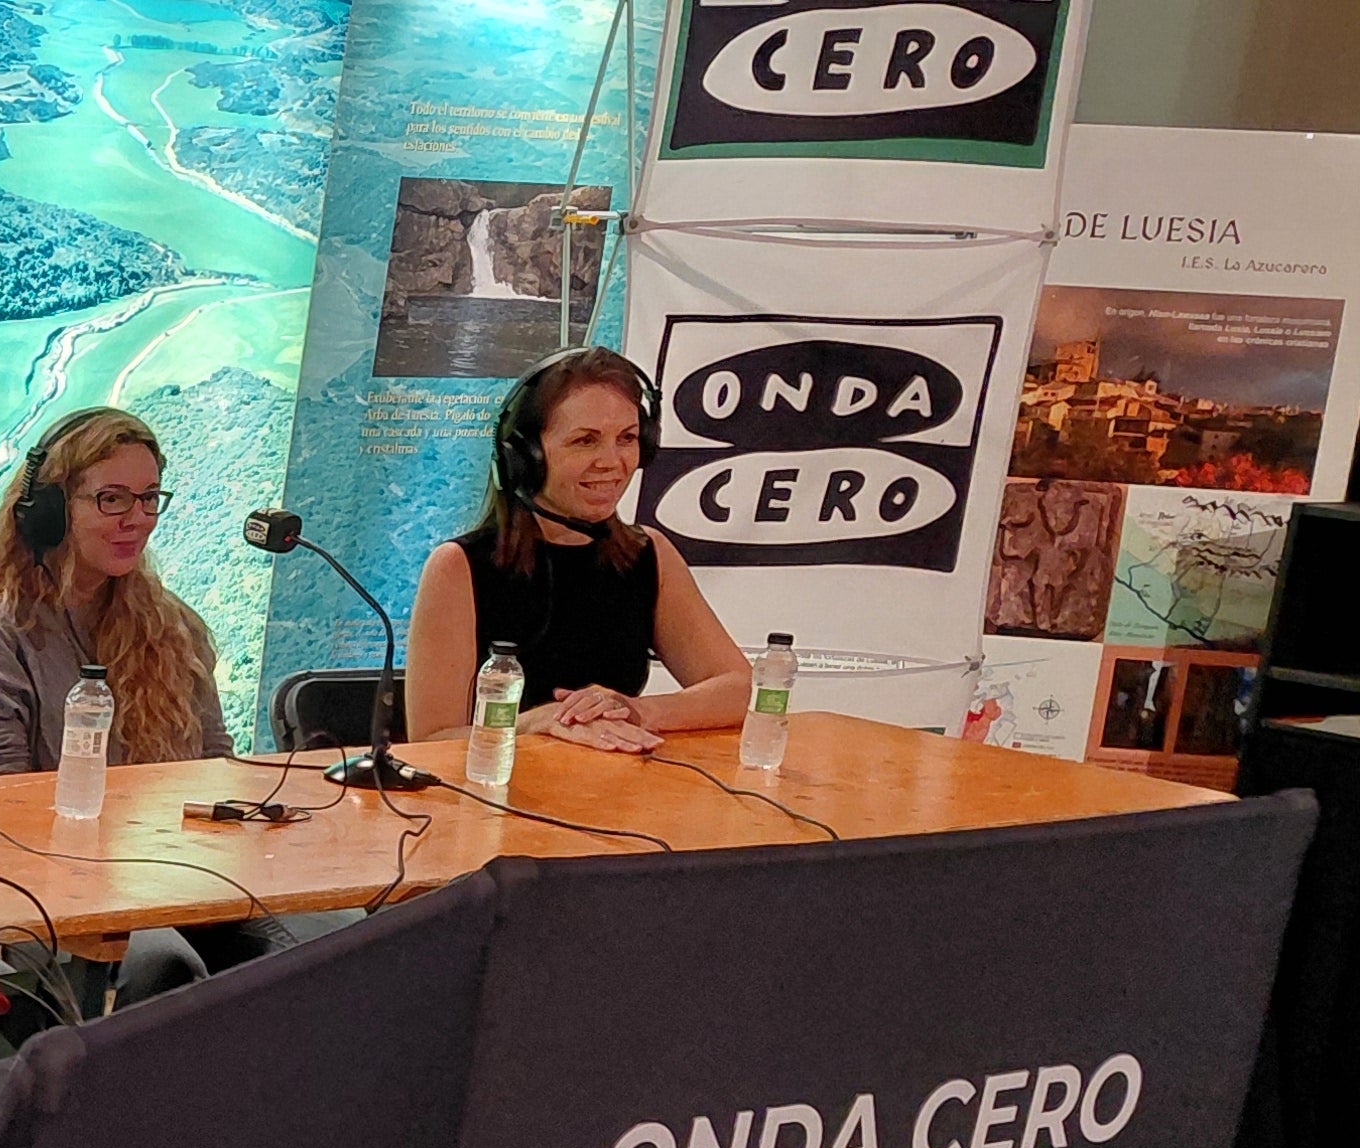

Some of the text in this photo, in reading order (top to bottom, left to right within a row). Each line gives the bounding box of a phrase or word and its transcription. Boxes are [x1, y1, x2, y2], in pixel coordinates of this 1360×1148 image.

[751, 28, 995, 91] CERO
[1065, 212, 1241, 245] DE LUESIA
[1224, 258, 1240, 272] La
[1245, 260, 1327, 275] Azucarera
[702, 370, 932, 419] ONDA
[699, 469, 919, 523] CERO
